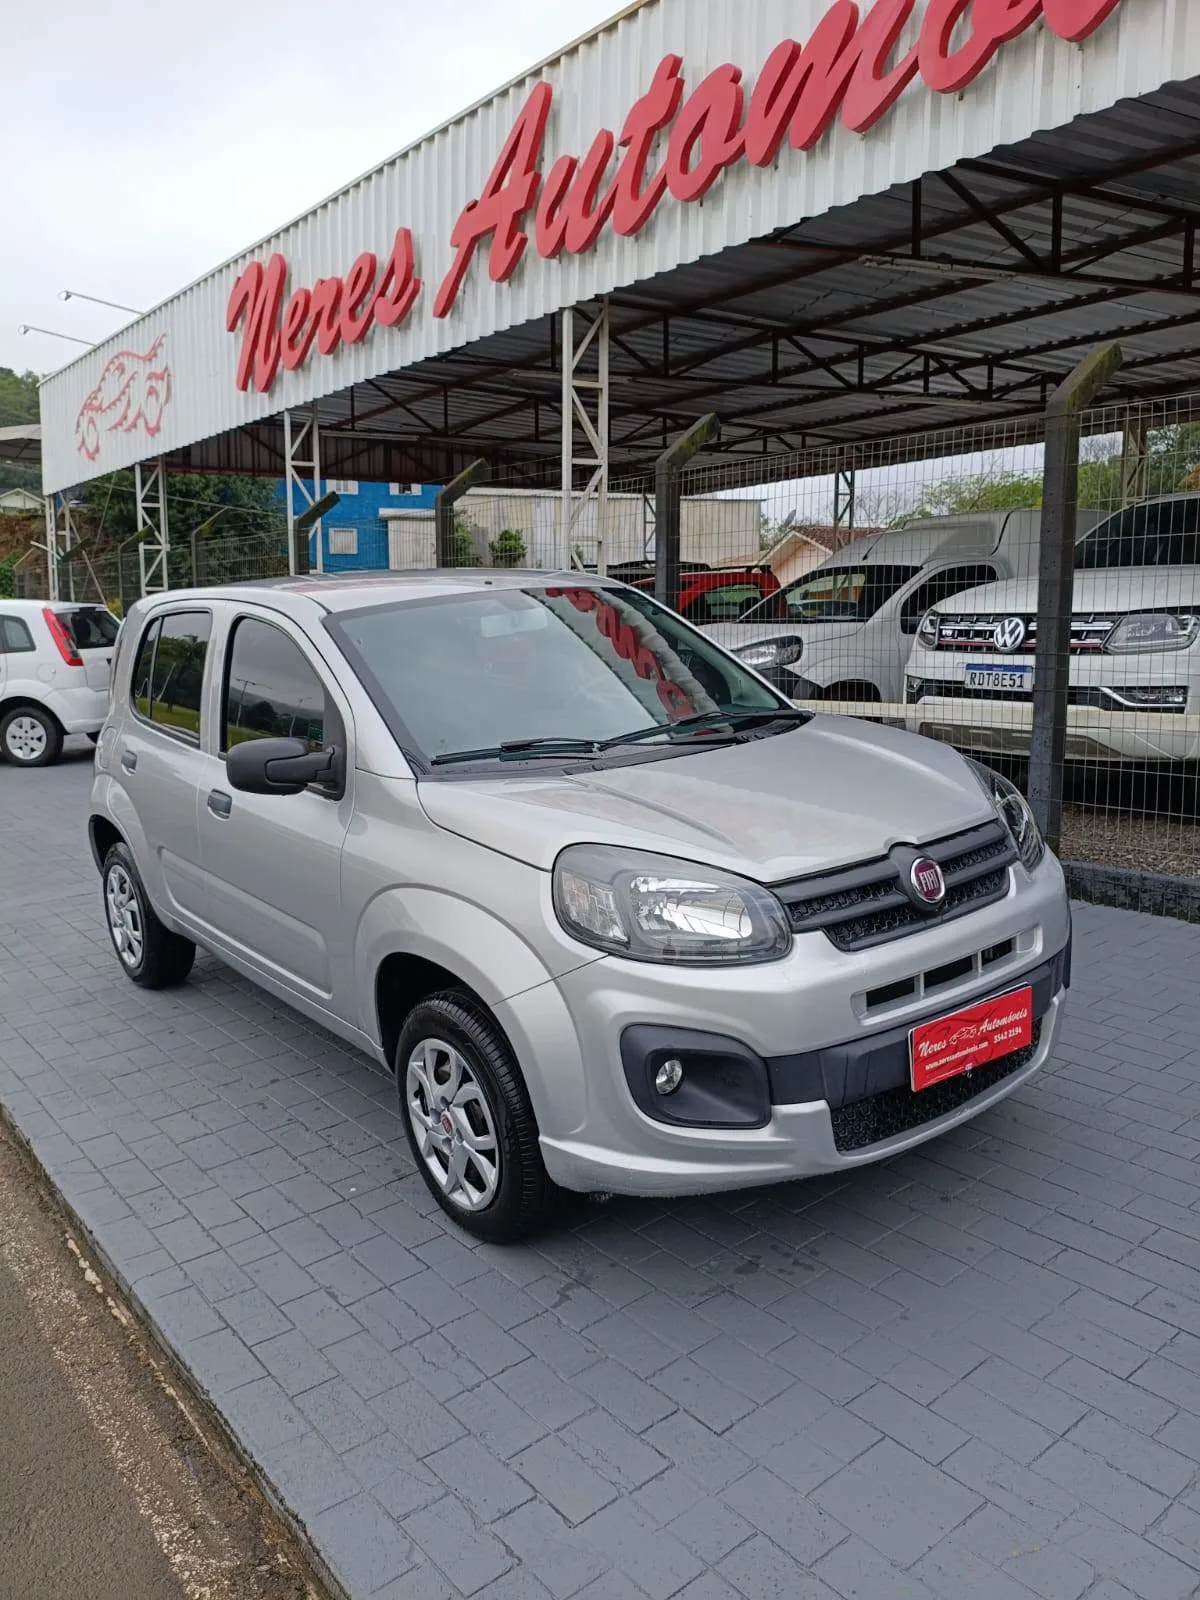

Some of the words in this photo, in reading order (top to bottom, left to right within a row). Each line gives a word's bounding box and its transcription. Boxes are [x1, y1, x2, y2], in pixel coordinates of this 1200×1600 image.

[226, 227, 421, 394] Neres
[969, 672, 1025, 689] RDT8E51
[918, 1038, 948, 1057] Neres
